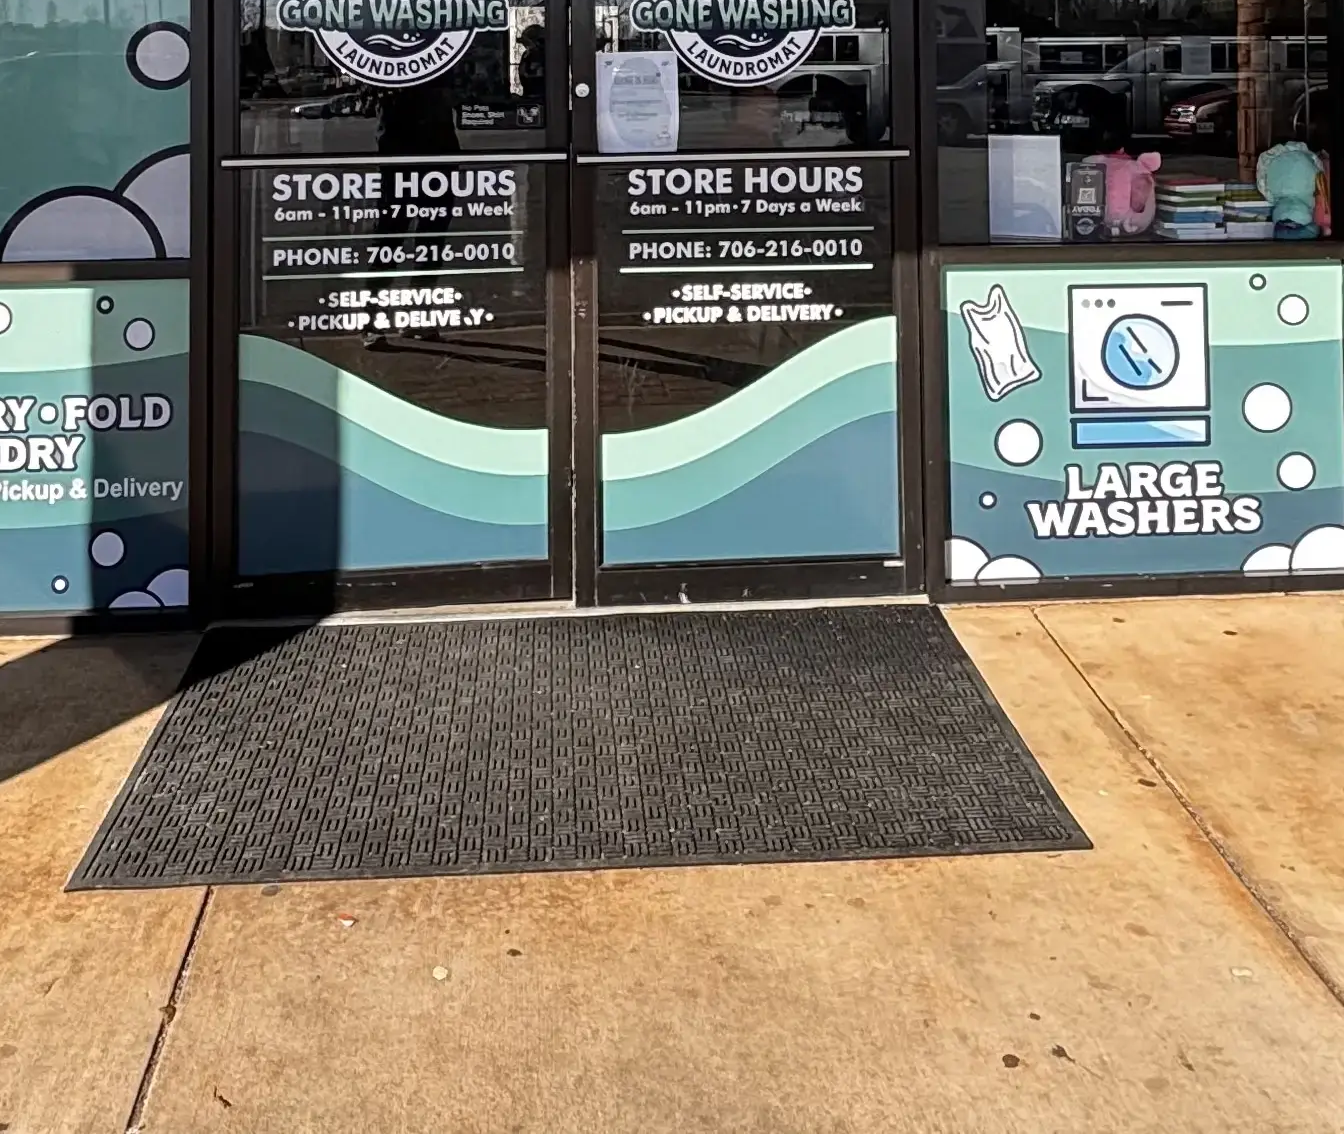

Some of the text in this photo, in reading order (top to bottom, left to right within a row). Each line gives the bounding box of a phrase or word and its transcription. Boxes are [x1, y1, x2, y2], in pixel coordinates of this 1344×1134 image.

[336, 37, 457, 77] LAUNDROMAT
[687, 37, 804, 77] LAUNDROMAT
[272, 169, 517, 201] STORE HOURS
[627, 166, 863, 196] STORE HOURS
[274, 207, 313, 222] 6am
[406, 203, 447, 220] Days
[451, 206, 463, 217] a
[467, 201, 515, 217] Week
[630, 201, 667, 216] 6am
[756, 199, 796, 216] Days
[800, 202, 811, 213] a
[815, 197, 862, 213] Week
[273, 242, 516, 267] PHONE: 706-216-0010
[629, 239, 863, 260] PHONE: 706-216-0010
[298, 312, 369, 332] PICKUP
[373, 312, 391, 330] &
[652, 306, 723, 325] PICKUP
[726, 306, 743, 323] &
[65, 394, 173, 430] FOLD
[69, 480, 88, 499] &
[93, 476, 184, 505] Delivery
[1066, 462, 1223, 500] LARGE
[1025, 497, 1263, 538] WASHERS
